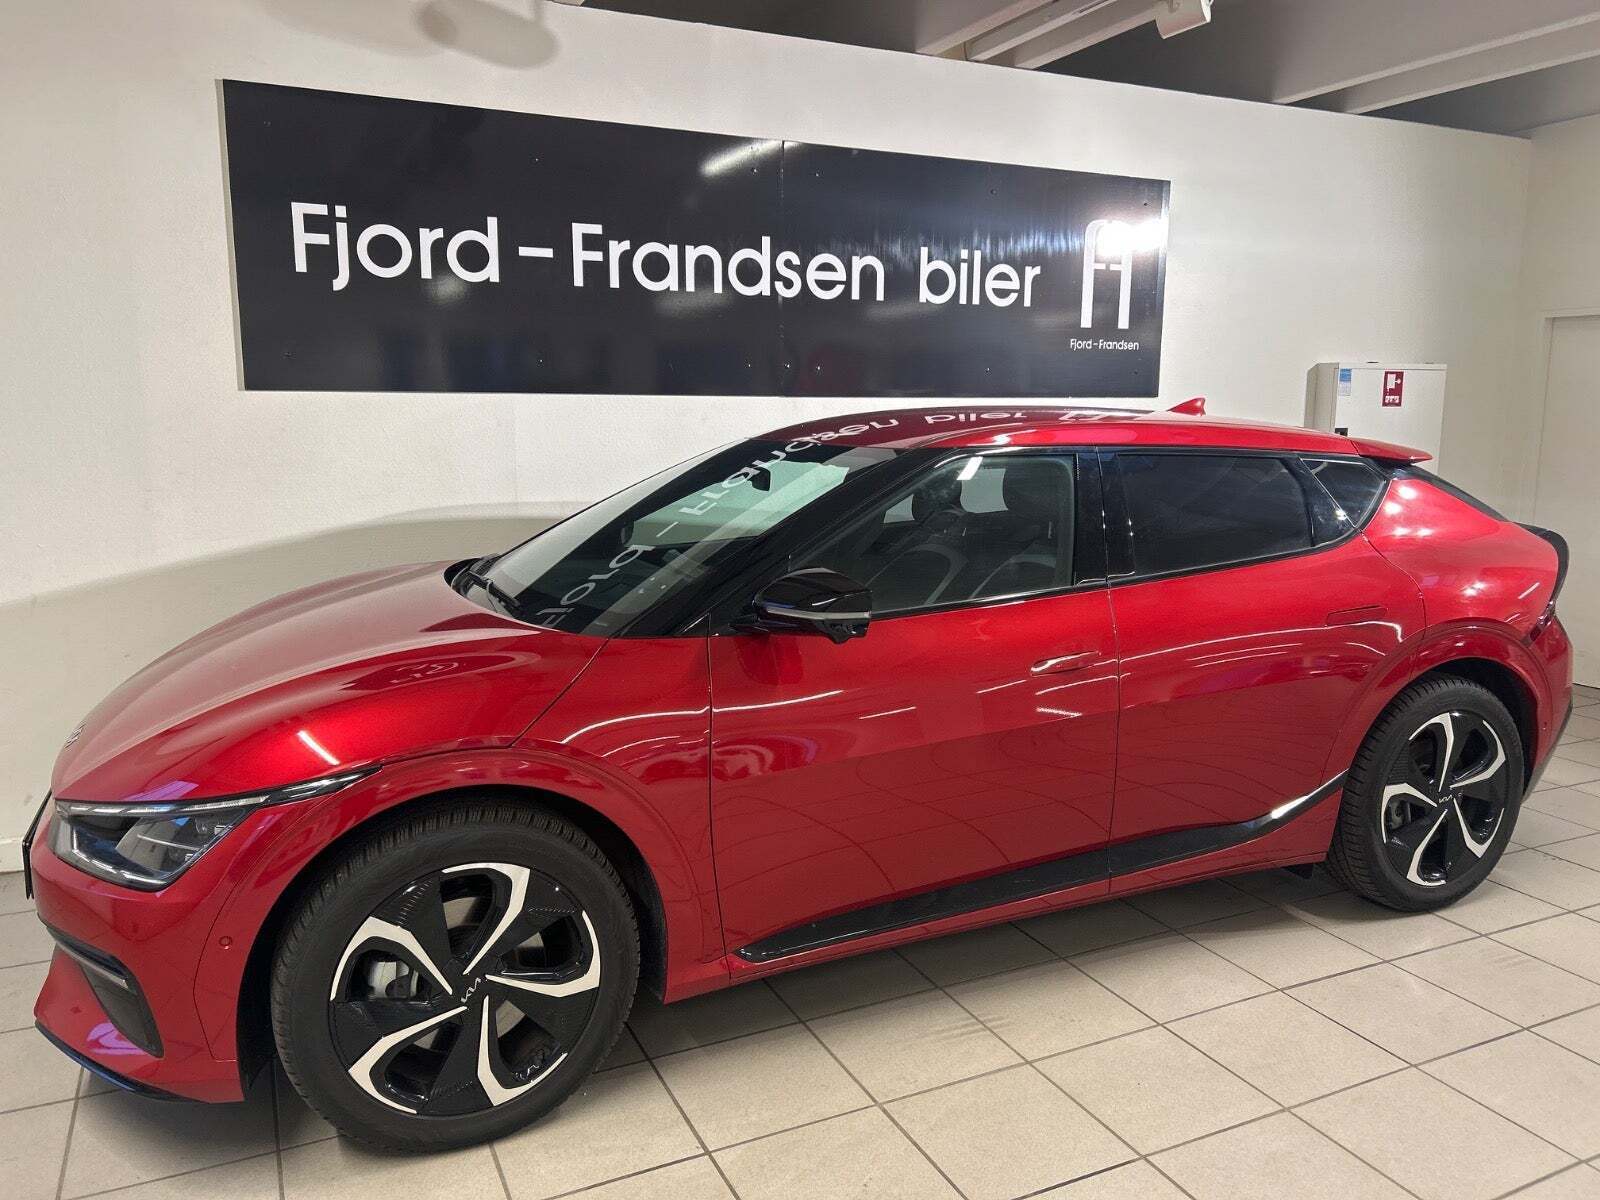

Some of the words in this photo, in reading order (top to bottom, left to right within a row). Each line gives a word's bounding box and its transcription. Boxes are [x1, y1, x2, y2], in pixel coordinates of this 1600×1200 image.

[290, 201, 500, 291] Fjord
[571, 222, 885, 302] Frandsen
[918, 246, 1041, 308] biler
